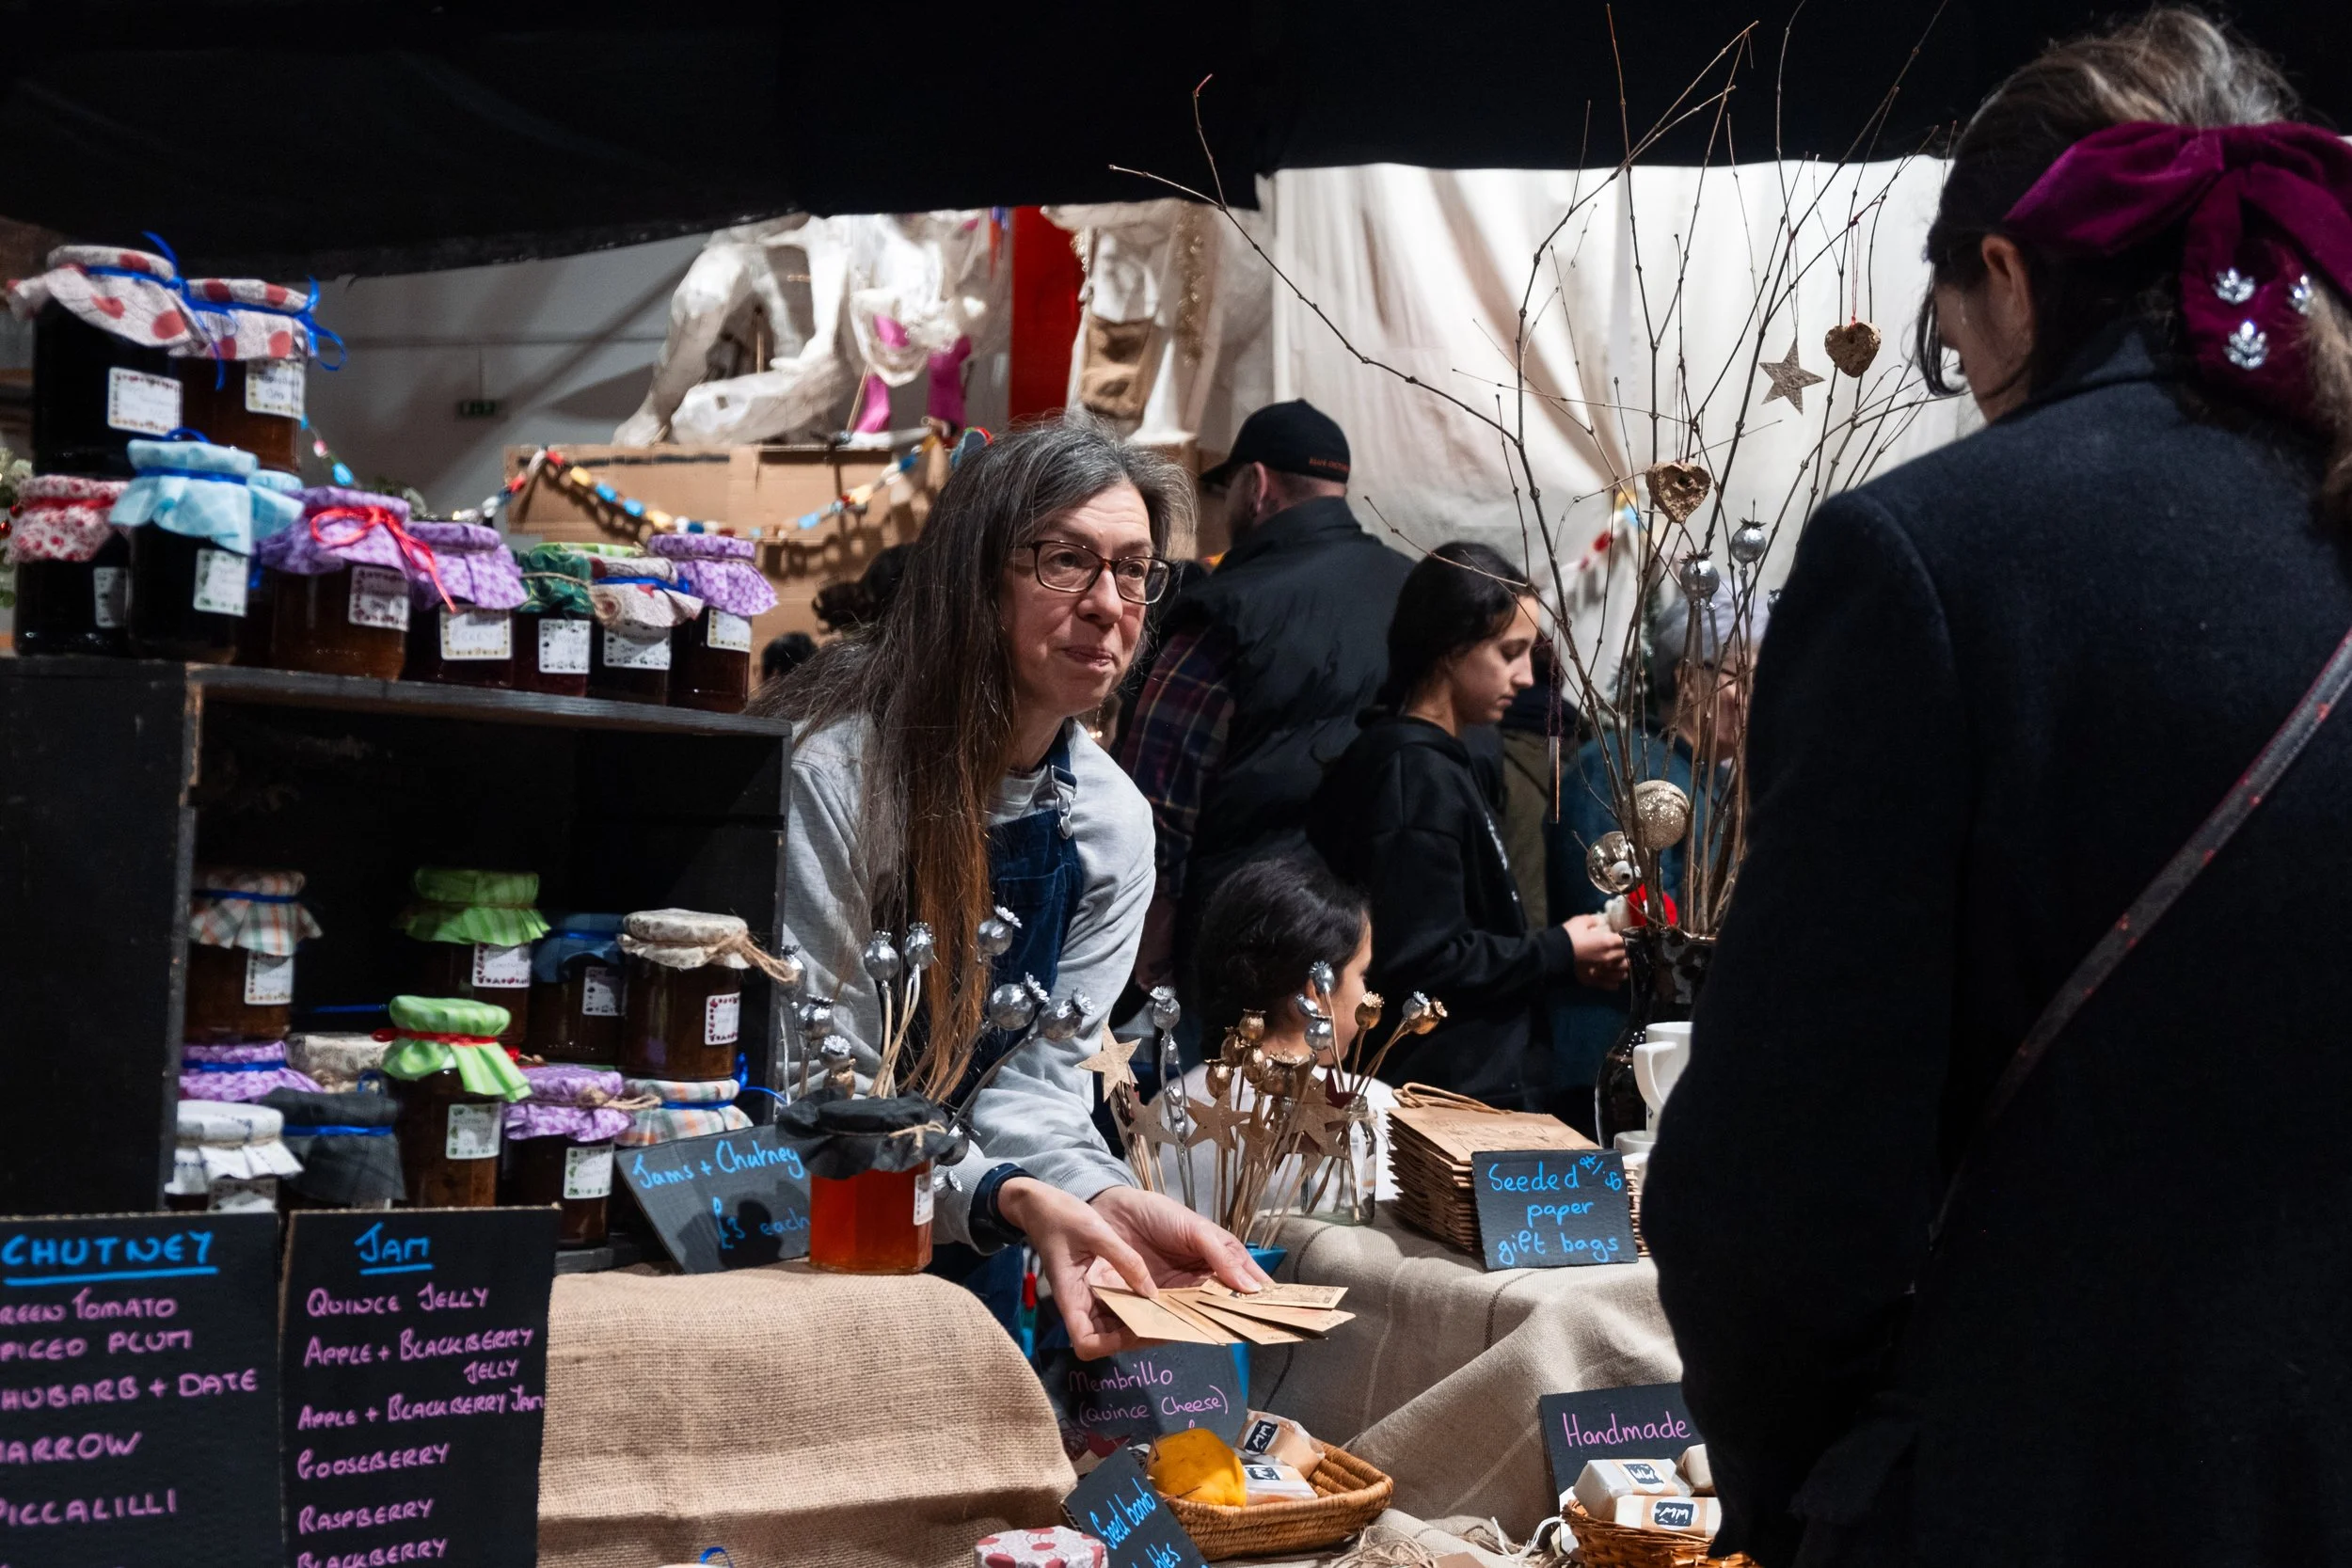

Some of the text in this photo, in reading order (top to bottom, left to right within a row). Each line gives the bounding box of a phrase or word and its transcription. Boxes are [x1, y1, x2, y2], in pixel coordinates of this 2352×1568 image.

[632, 1153, 694, 1189] Jams
[1488, 1161, 1580, 1192] Seeded
[759, 1207, 811, 1235] each
[1526, 1202, 1594, 1228] paper
[1, 1231, 214, 1265] CHUTNEY
[1498, 1230, 1619, 1265] gift bags
[0, 1305, 67, 1324] REEN
[306, 1282, 489, 1318] QUINCE JELLY
[0, 1338, 87, 1362] PICED
[0, 1375, 141, 1411] HUBARB
[178, 1368, 259, 1398] DATE
[1069, 1361, 1173, 1393] Membrillo
[1079, 1385, 1229, 1427] (Quince Cheese)
[1562, 1411, 1691, 1447] Handmade
[1089, 1478, 1156, 1550] Seed bomb
